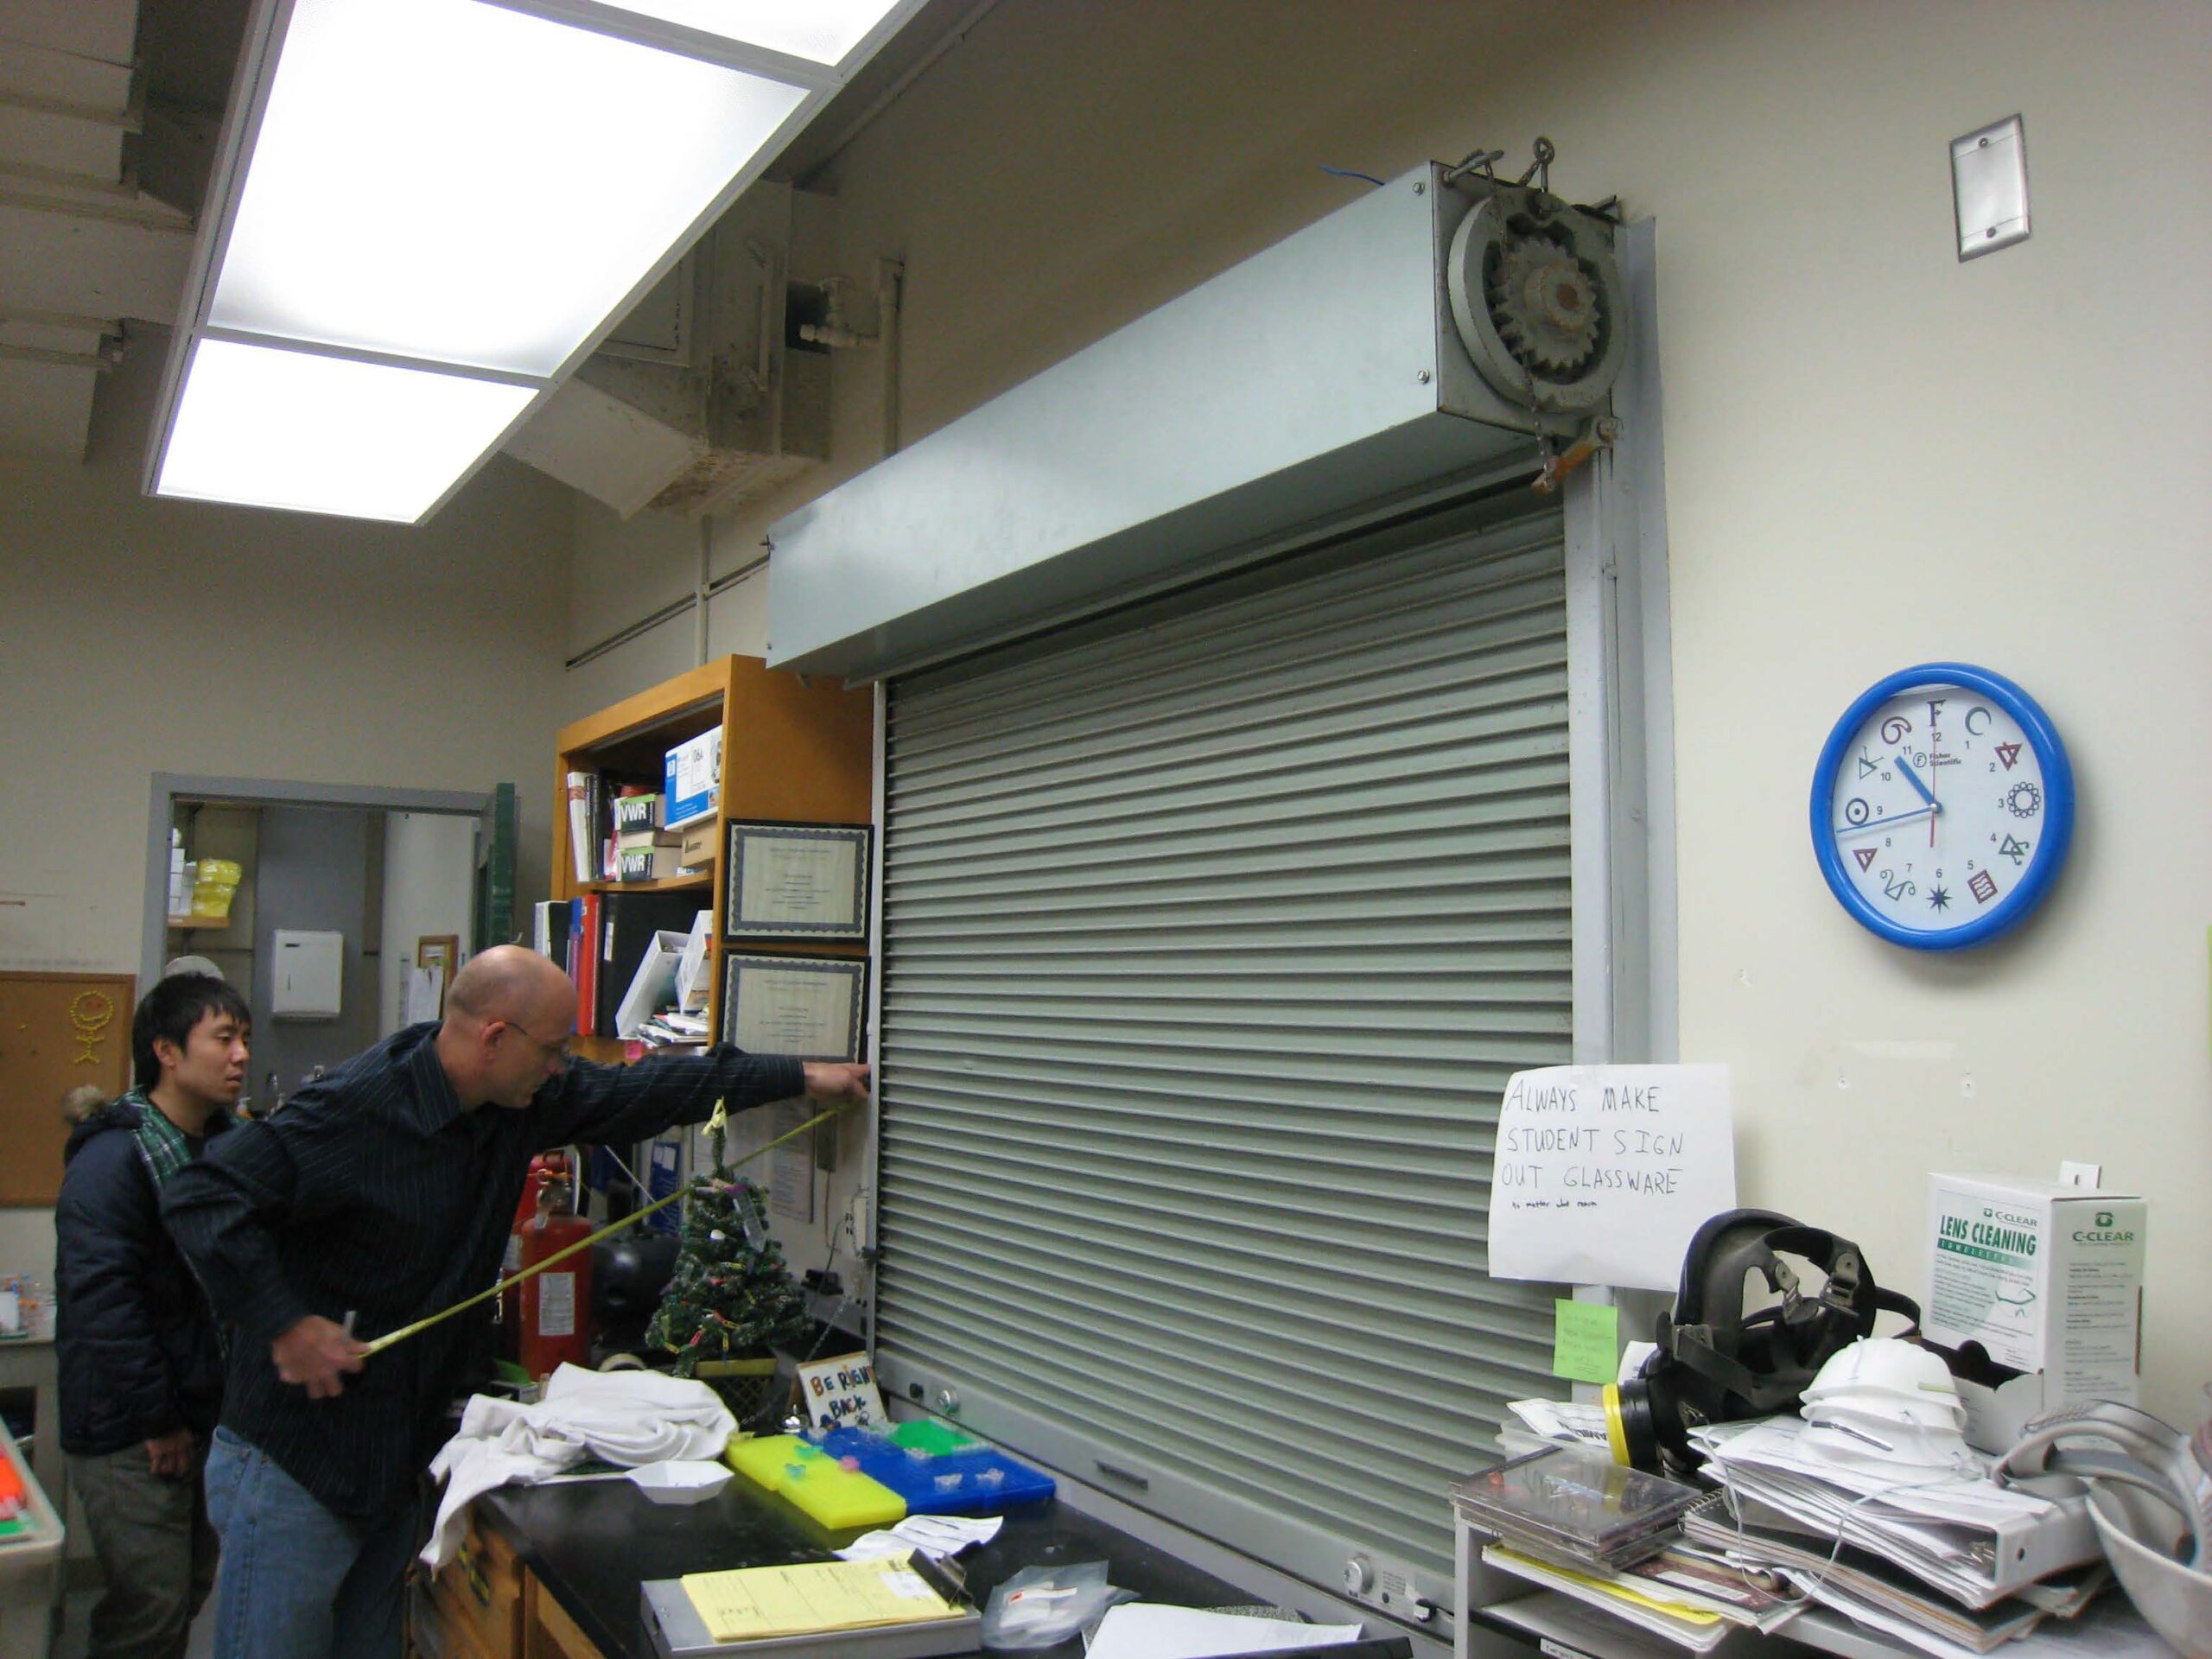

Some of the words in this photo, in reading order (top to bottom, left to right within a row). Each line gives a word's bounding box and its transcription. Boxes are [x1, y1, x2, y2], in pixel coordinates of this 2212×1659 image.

[1931, 732, 1942, 742] 12
[1902, 745, 1912, 755] 11
[1929, 757, 1962, 767] Scientific
[1989, 763, 1996, 772] 2
[1880, 772, 1891, 782] 10
[1998, 798, 2005, 809] 3
[621, 802, 647, 822] VWR
[1876, 805, 1883, 816] 9
[1885, 837, 1891, 848] 8
[1990, 833, 1997, 842] 4
[621, 854, 645, 874] VWR
[1906, 862, 1912, 873] 7
[1967, 860, 1974, 870] 5
[1936, 868, 1942, 879] 6
[1505, 1078, 1578, 1113] ALWAYS
[1602, 1085, 1661, 1113] MAKE
[1507, 1126, 1600, 1153] STUDENT
[1613, 1129, 1684, 1157] SIGN
[1501, 1162, 1542, 1189] OUT
[1563, 1166, 1684, 1195] GLASSWARE
[1995, 1211, 2037, 1227] C-CLEAR
[1940, 1214, 1968, 1240] LENS
[1971, 1221, 2037, 1256] CLEANING
[2072, 1230, 2135, 1243] C-CLEAR
[810, 1376, 835, 1396] BE
[837, 1364, 874, 1391] RIGHT
